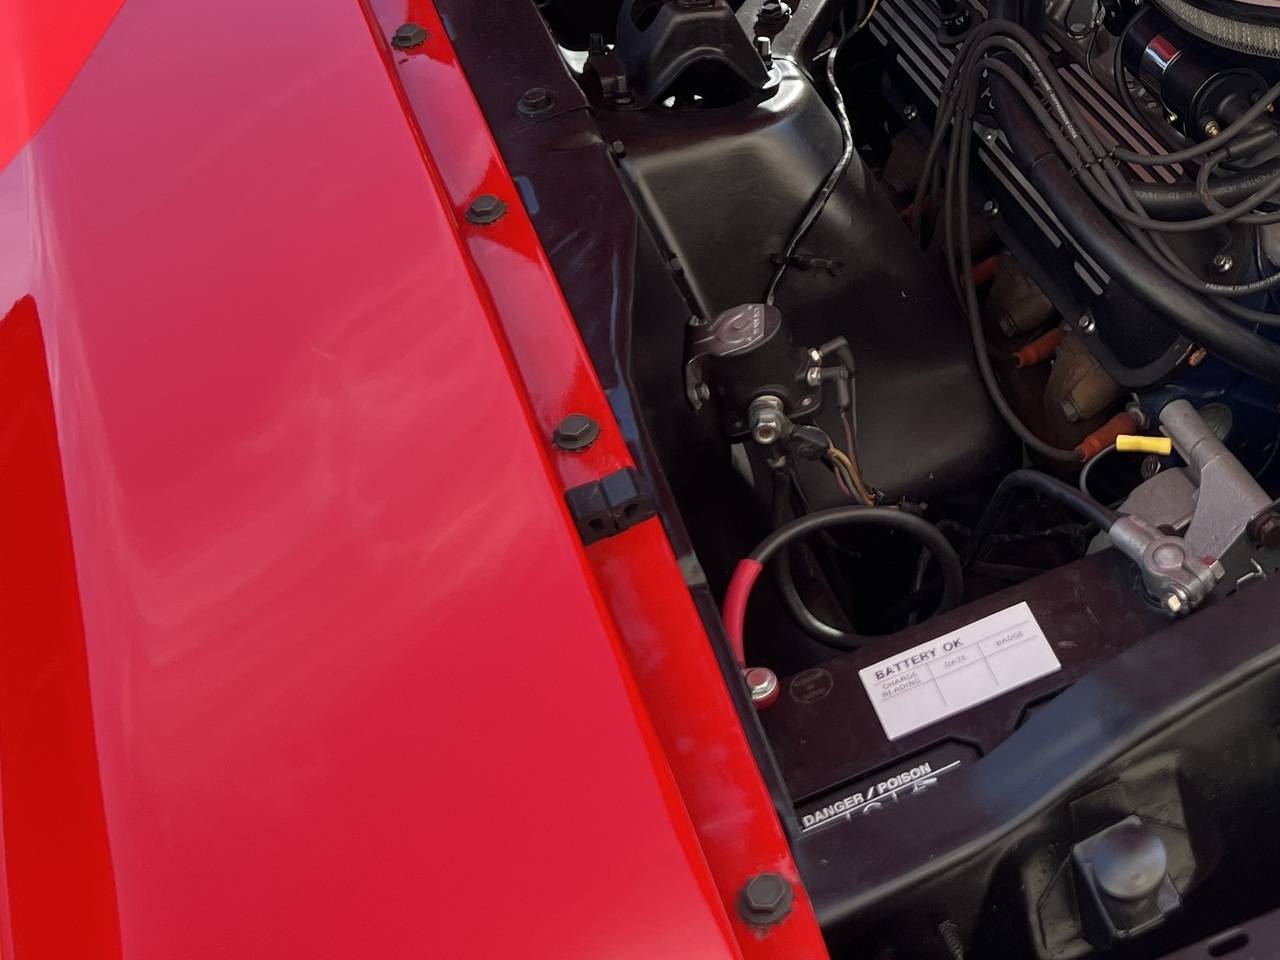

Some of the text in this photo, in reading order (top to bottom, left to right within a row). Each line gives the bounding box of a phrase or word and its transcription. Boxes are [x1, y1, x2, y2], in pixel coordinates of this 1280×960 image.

[875, 637, 965, 681] BATTERY OK
[944, 654, 968, 668] DATE
[882, 671, 918, 690] CHARGE
